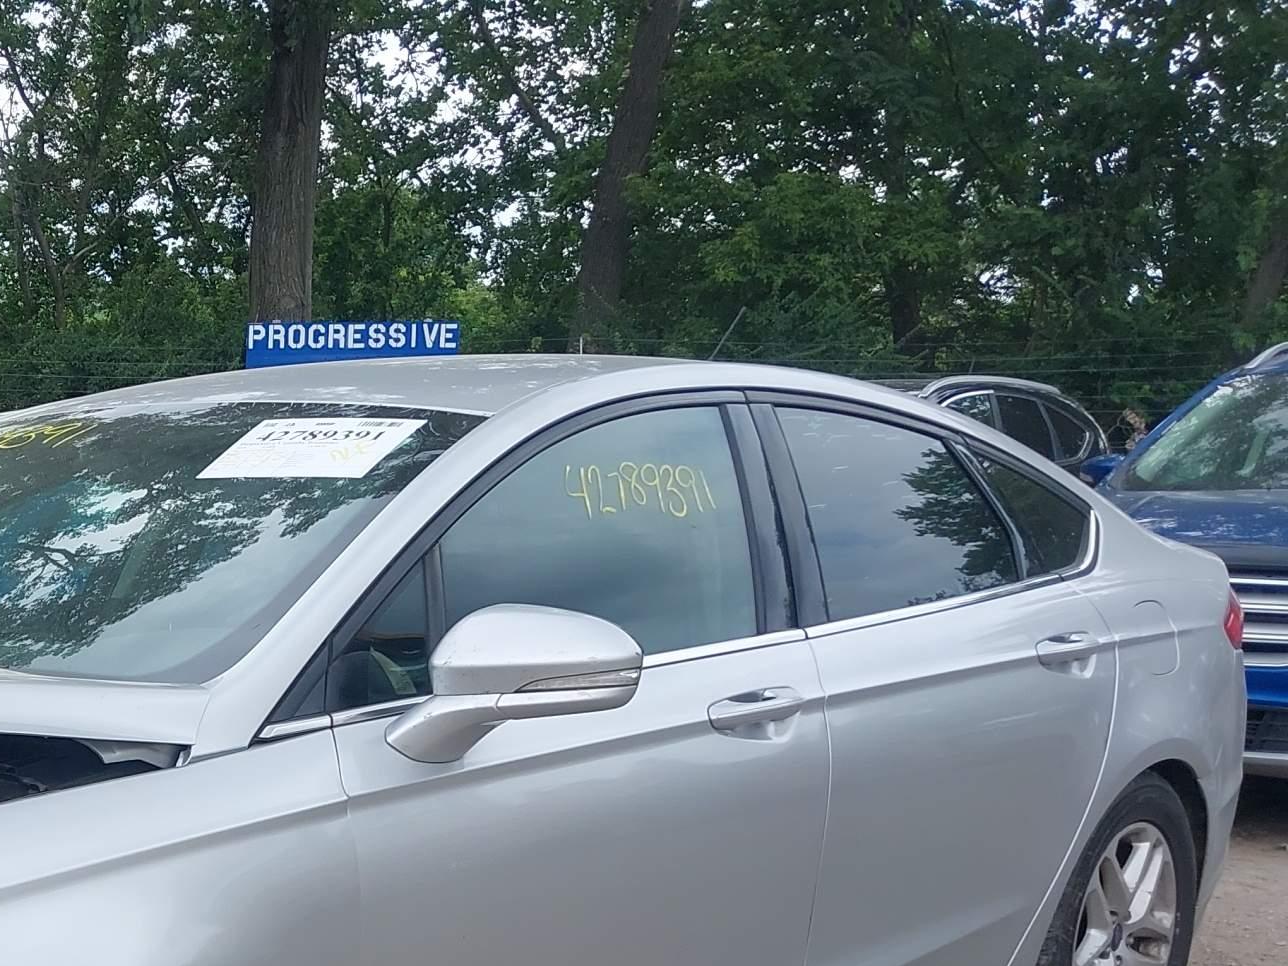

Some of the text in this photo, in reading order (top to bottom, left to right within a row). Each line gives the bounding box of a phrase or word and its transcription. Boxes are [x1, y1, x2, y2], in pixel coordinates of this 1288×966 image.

[247, 322, 458, 350] PROGRESSIVE
[255, 430, 386, 442] 42789391
[565, 461, 718, 521] 42789391
